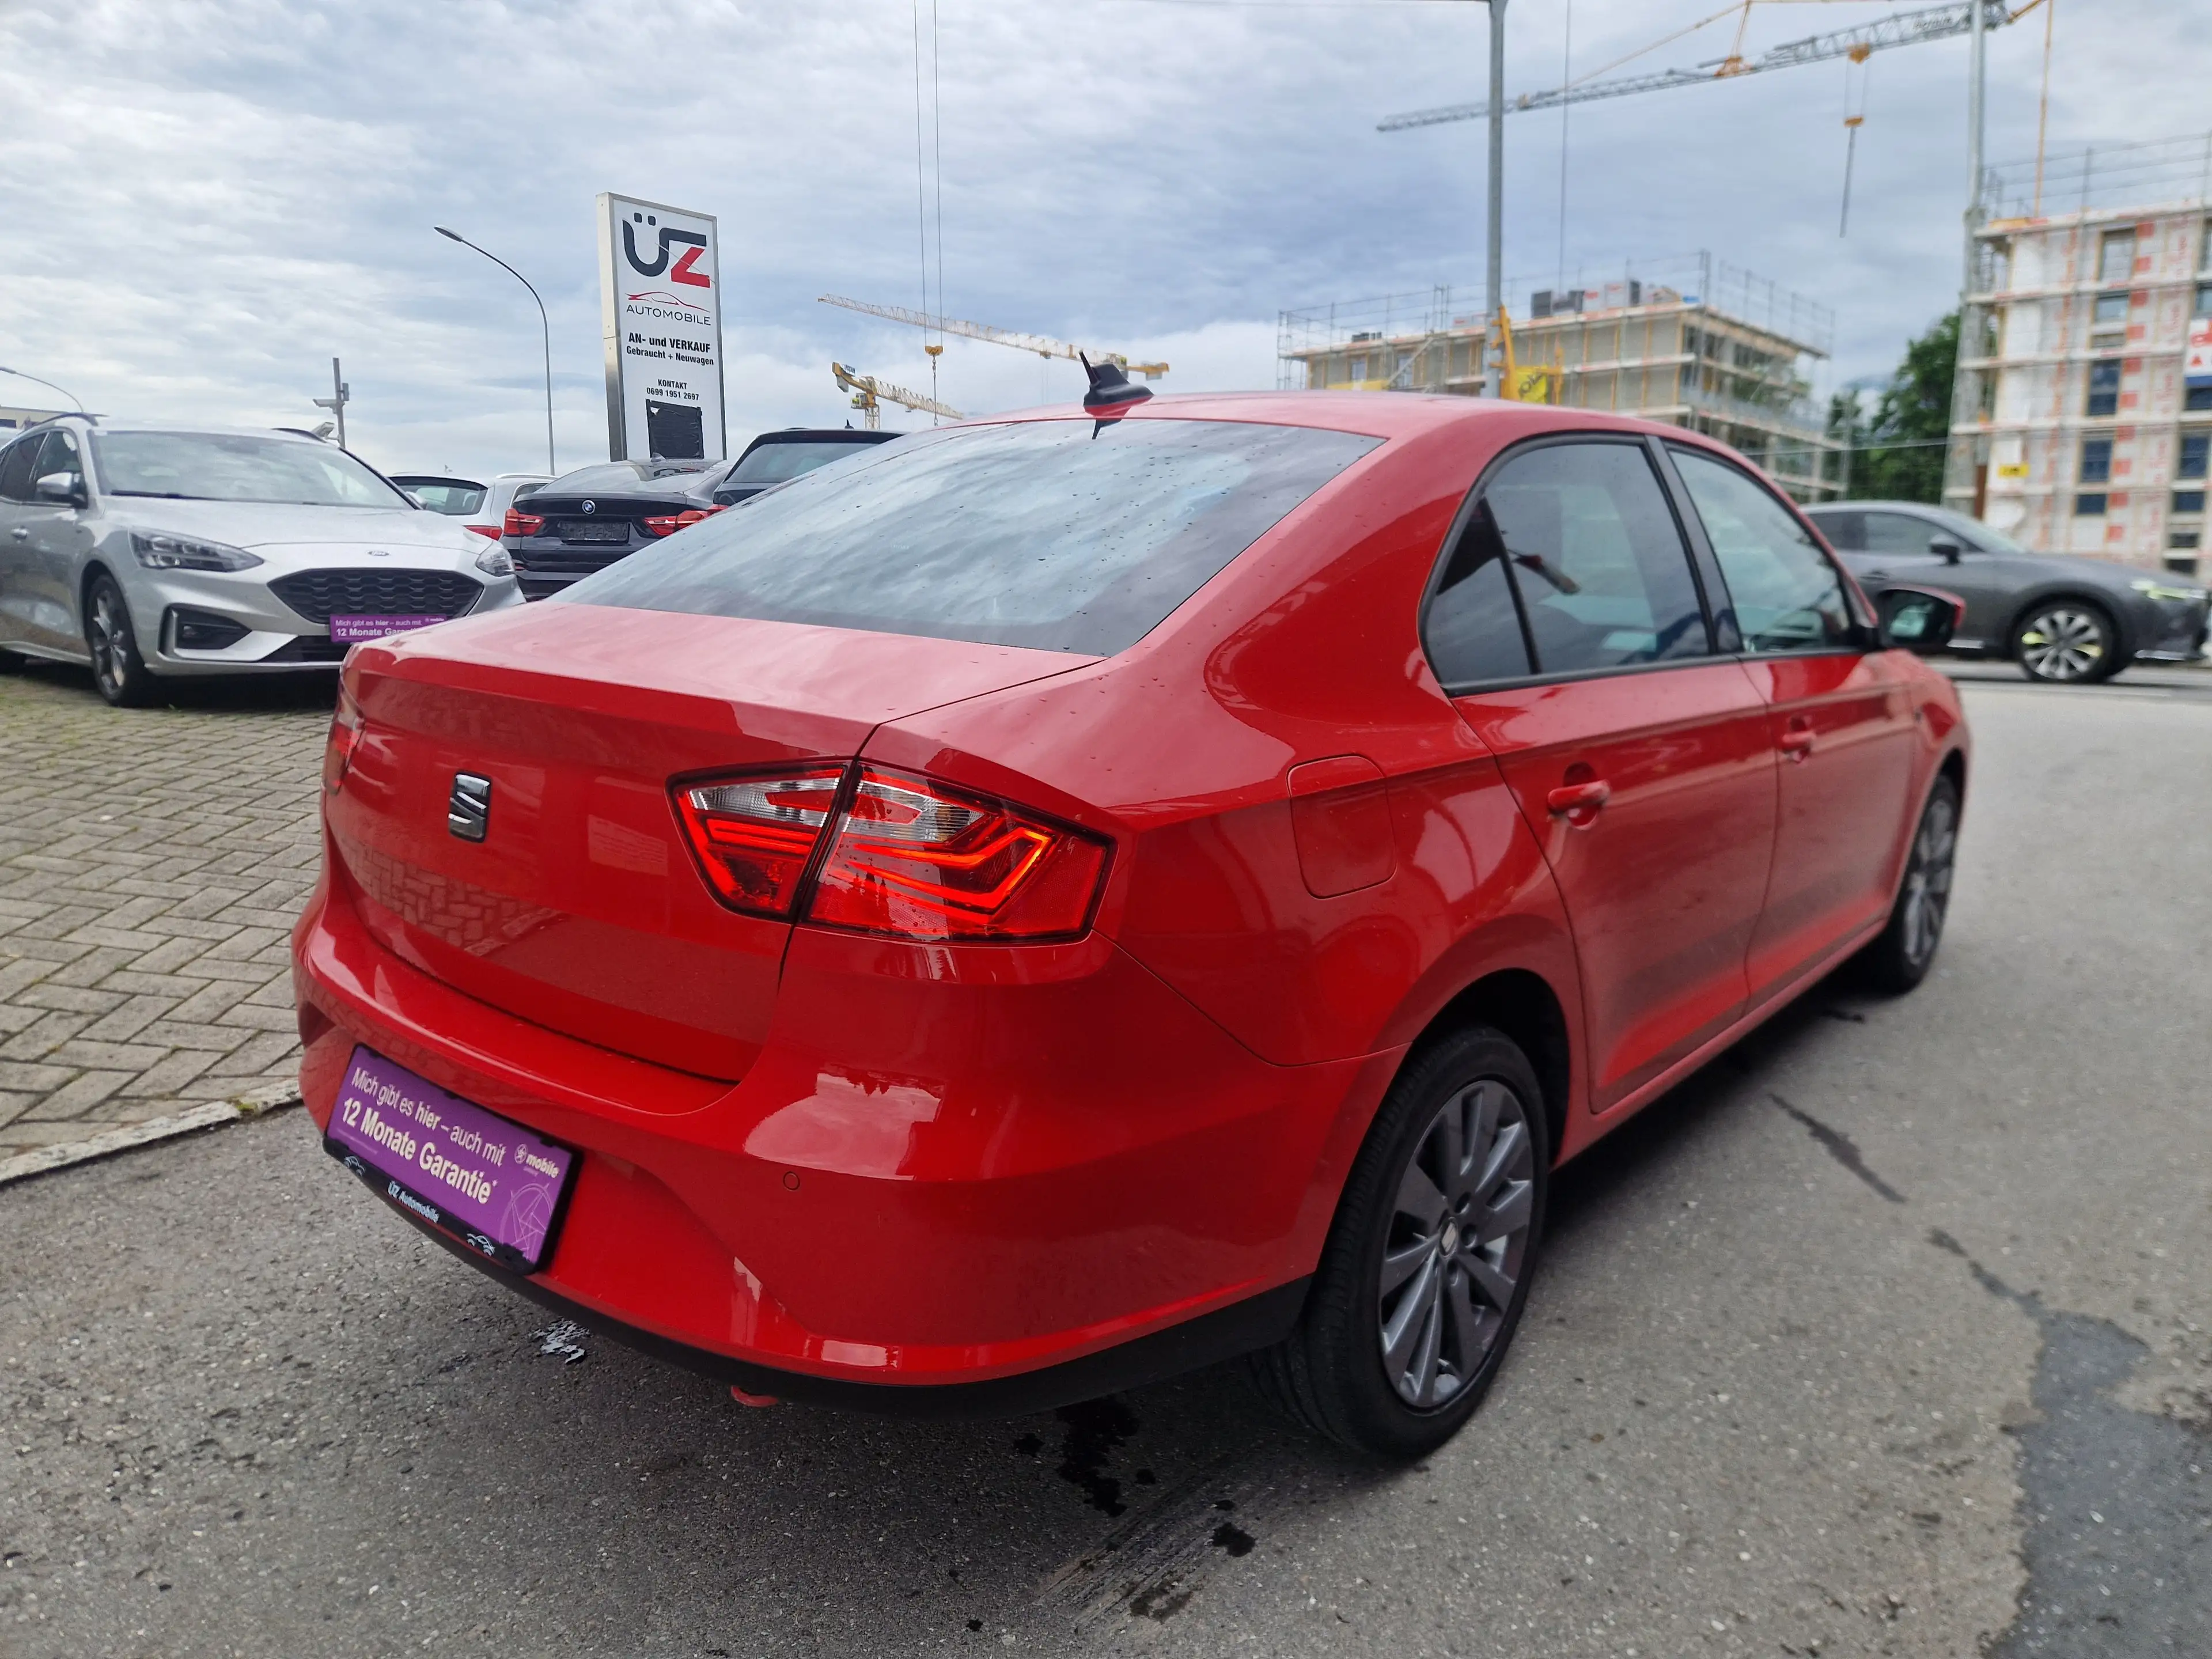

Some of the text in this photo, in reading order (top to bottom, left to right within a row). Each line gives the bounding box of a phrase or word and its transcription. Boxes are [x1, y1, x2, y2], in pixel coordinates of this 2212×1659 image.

[626, 304, 711, 325] AUTOMOBILE
[628, 332, 711, 353] AN- und VERKAUF
[626, 346, 666, 359] Gebraucht
[676, 353, 714, 366] Neuwagen
[646, 387, 699, 400] 0699 1951 2697
[658, 378, 687, 389] KONTAKT
[336, 627, 416, 637] 12 Monate Gara
[352, 619, 365, 627] gibt
[351, 1067, 379, 1097] Mich
[376, 1084, 401, 1109] gibt
[399, 1097, 415, 1116] es
[414, 1101, 441, 1131] hier
[450, 1125, 483, 1155] auch
[482, 1142, 507, 1168] mit
[342, 1097, 362, 1127] 12
[360, 1107, 417, 1161] Monate
[526, 1154, 560, 1179] mobile
[399, 1191, 440, 1224] Automobile
